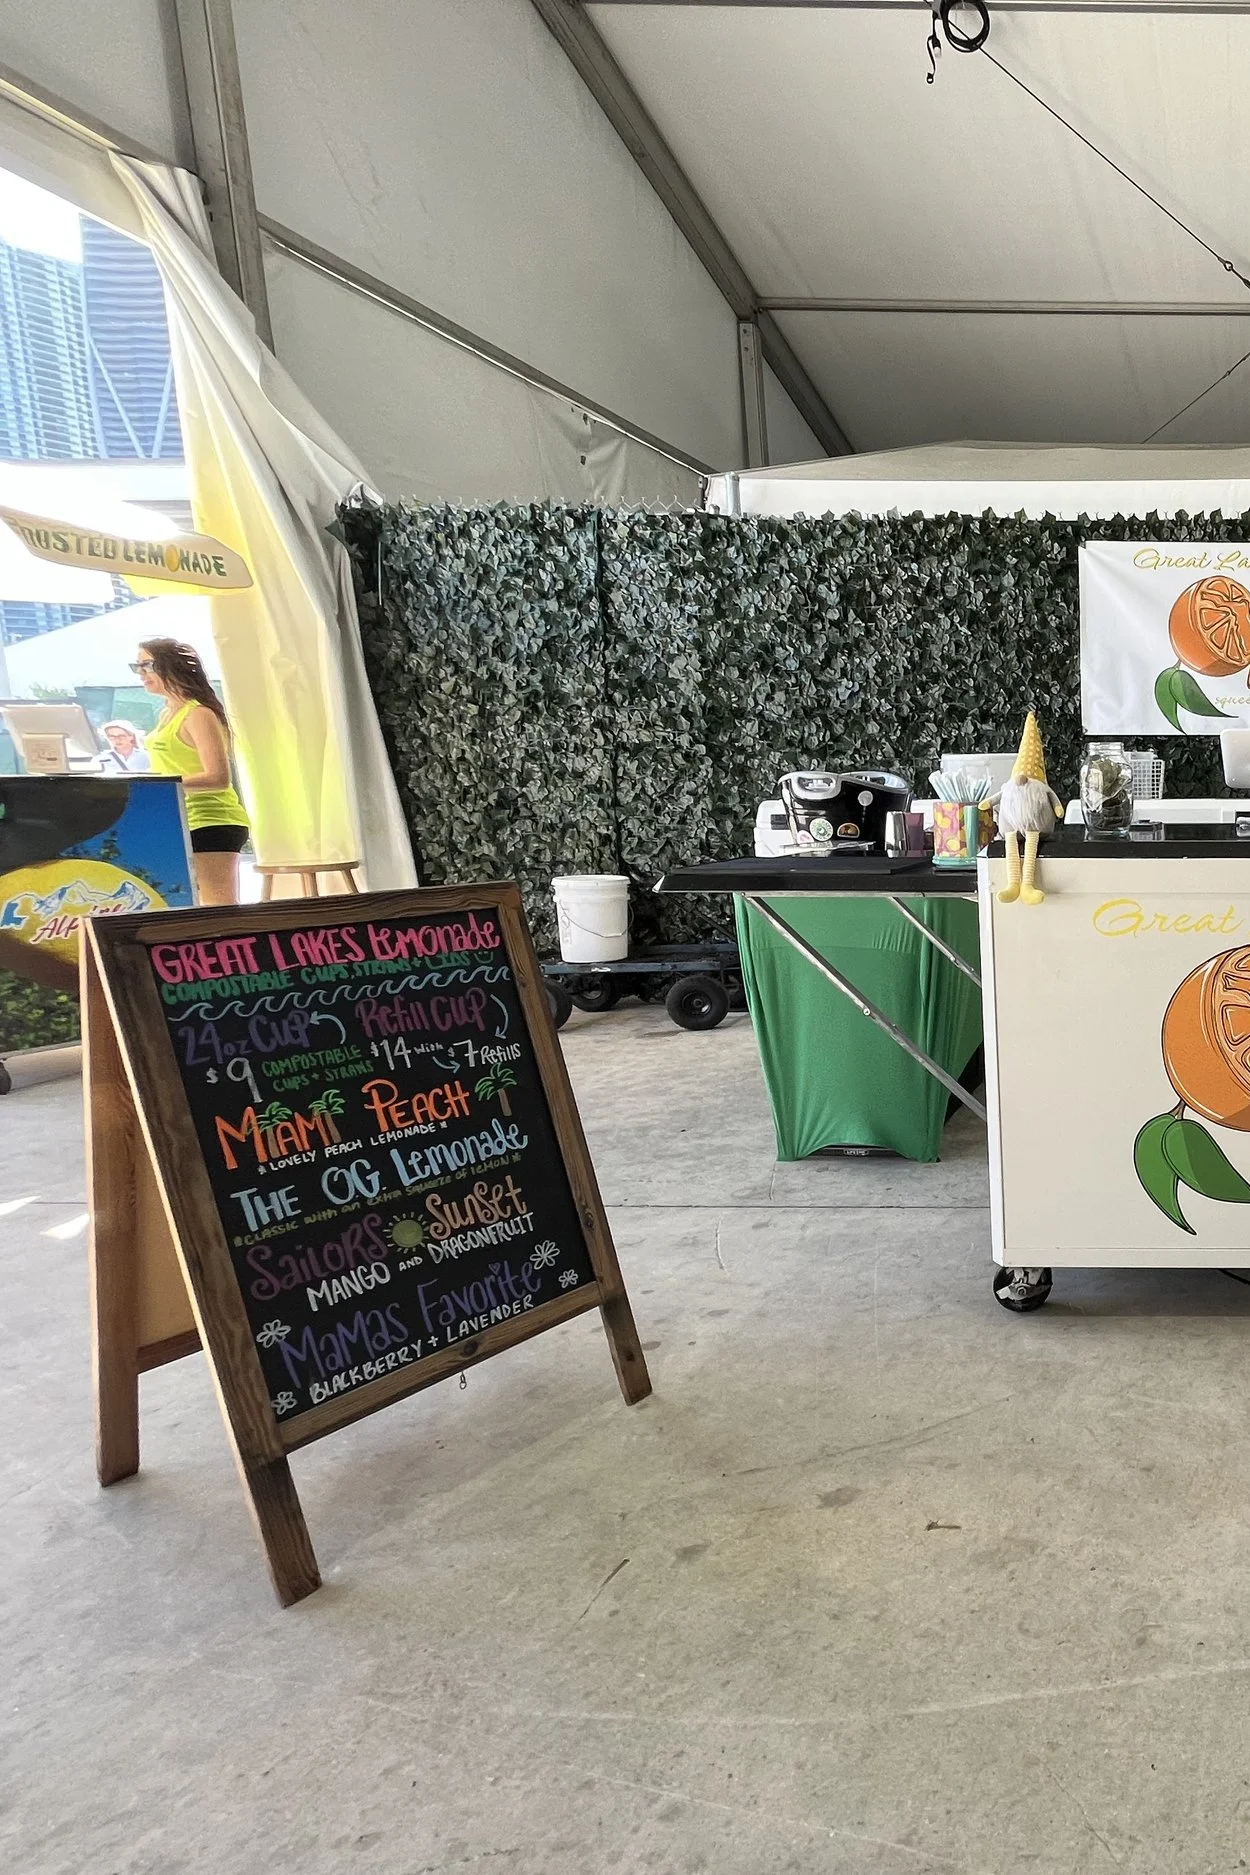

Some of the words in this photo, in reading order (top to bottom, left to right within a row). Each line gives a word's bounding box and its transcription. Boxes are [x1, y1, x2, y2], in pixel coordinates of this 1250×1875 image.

[1133, 547, 1211, 571] Great
[1092, 898, 1245, 938] Great
[152, 937, 258, 984] GREAT
[269, 926, 357, 971] LAKES
[162, 970, 294, 1004] COMPOSTABLE
[355, 995, 430, 1037] Refill
[262, 1044, 362, 1077] COMPOSTABLE
[273, 1073, 309, 1093] CUPS
[325, 1060, 374, 1085] STRAWS
[370, 1036, 411, 1071] $14
[480, 1042, 521, 1065] Refills
[361, 1078, 469, 1133] PEACH
[269, 1150, 316, 1174] LOVELY
[325, 1139, 363, 1159] PEACH
[371, 1122, 436, 1147] LEMONADE
[231, 1184, 302, 1232] THE
[390, 1118, 529, 1187] Lemonade
[244, 1222, 299, 1246] CLASSIC
[341, 1202, 361, 1215] an
[455, 1169, 468, 1181] of
[307, 1261, 391, 1311] MANGO
[399, 1256, 424, 1272] AND
[427, 1212, 535, 1264] DRAGONFRUIT
[417, 1261, 543, 1334] Favorite
[309, 1338, 422, 1405] BLACKBERRY
[447, 1293, 535, 1343] LAVENDER
